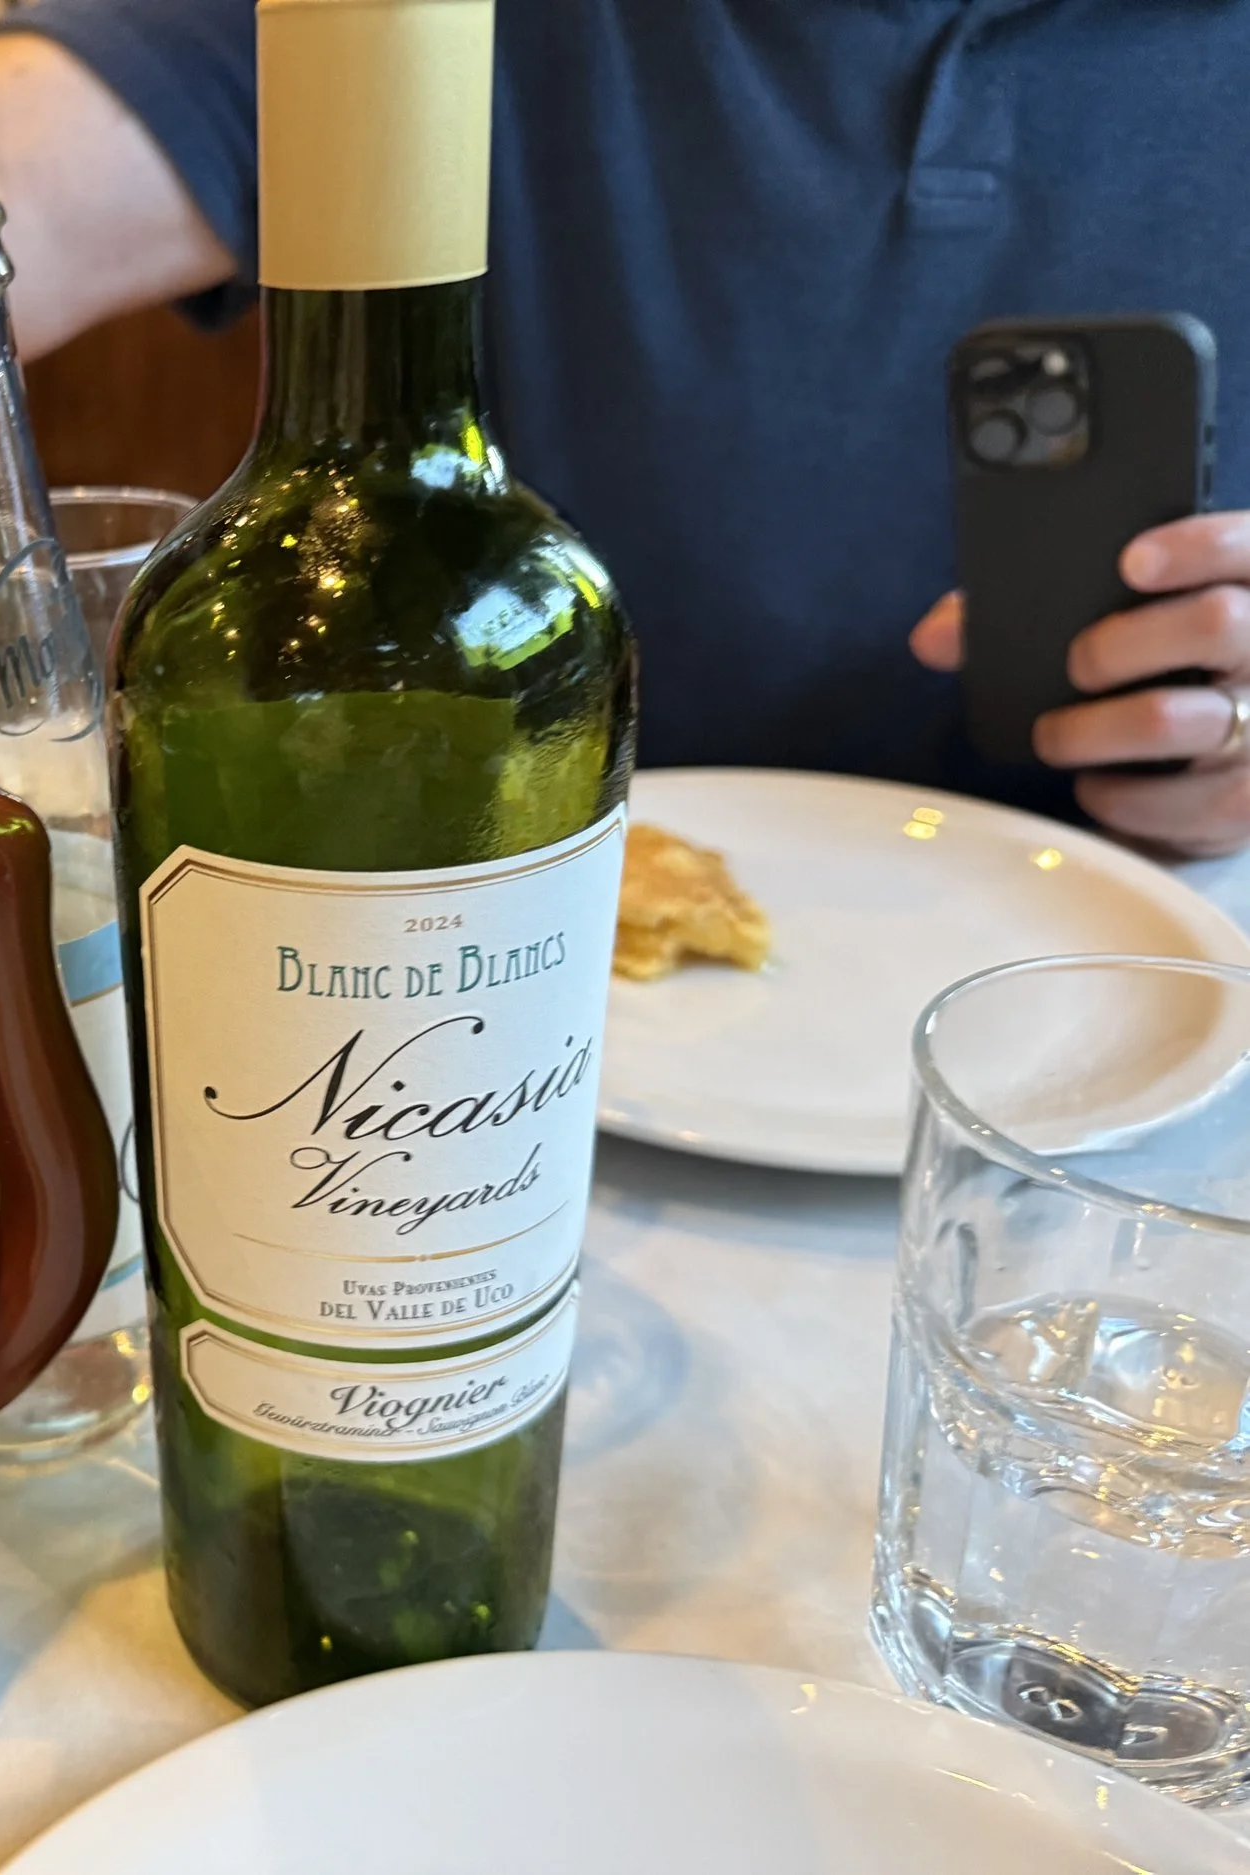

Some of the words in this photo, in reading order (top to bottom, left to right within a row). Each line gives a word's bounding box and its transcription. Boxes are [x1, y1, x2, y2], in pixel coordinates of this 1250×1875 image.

[403, 913, 464, 933] 2024
[276, 946, 391, 999] BLANC
[405, 963, 443, 998] DE
[457, 931, 566, 993] BLANCS
[204, 1016, 593, 1141] Nicasia
[290, 1142, 542, 1236] Vineyards
[320, 1301, 357, 1320] DEL
[366, 1300, 434, 1321] VALLE
[440, 1297, 468, 1317] DE
[474, 1283, 514, 1308] UCO
[343, 1280, 388, 1296] UVAS
[393, 1270, 497, 1296] PROVENIENTES
[330, 1375, 508, 1431] Viognier
